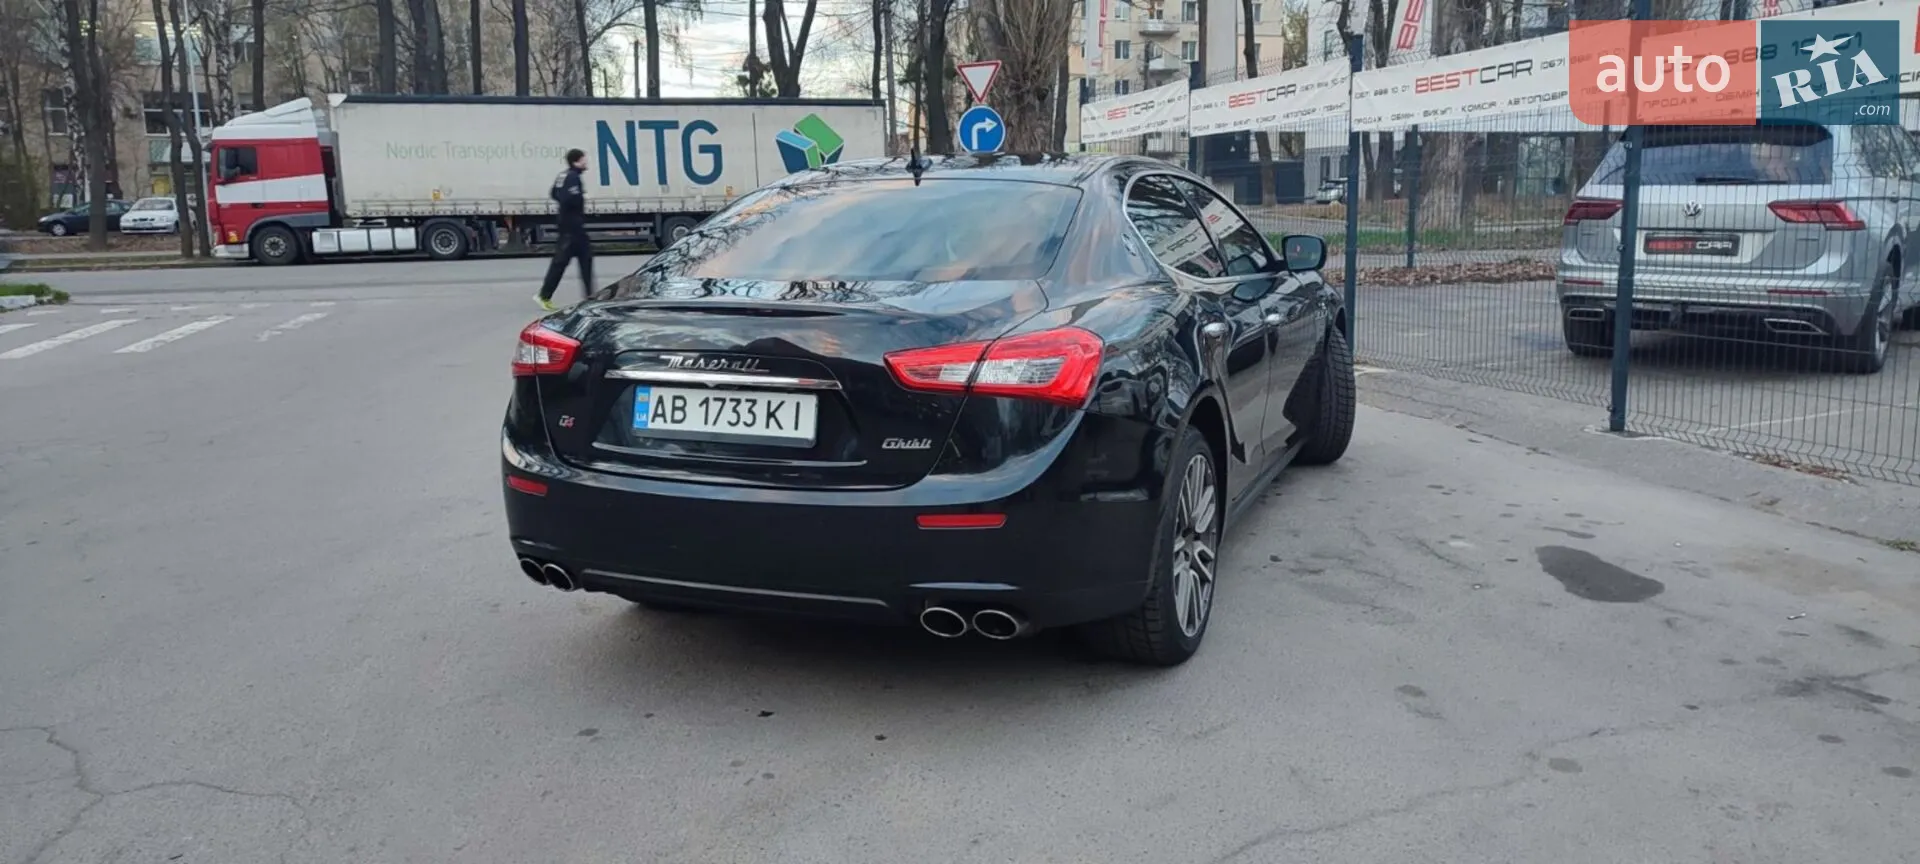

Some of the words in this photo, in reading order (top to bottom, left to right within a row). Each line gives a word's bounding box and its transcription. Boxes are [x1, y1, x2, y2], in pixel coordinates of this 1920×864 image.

[1415, 59, 1533, 94] BESTCAR
[1229, 83, 1297, 108] BESTCAR
[386, 142, 437, 160] Nordic
[443, 141, 514, 163] Transport
[520, 141, 568, 164] Group
[596, 119, 723, 186] NTG
[651, 395, 687, 424] AB
[699, 396, 756, 427] 1733
